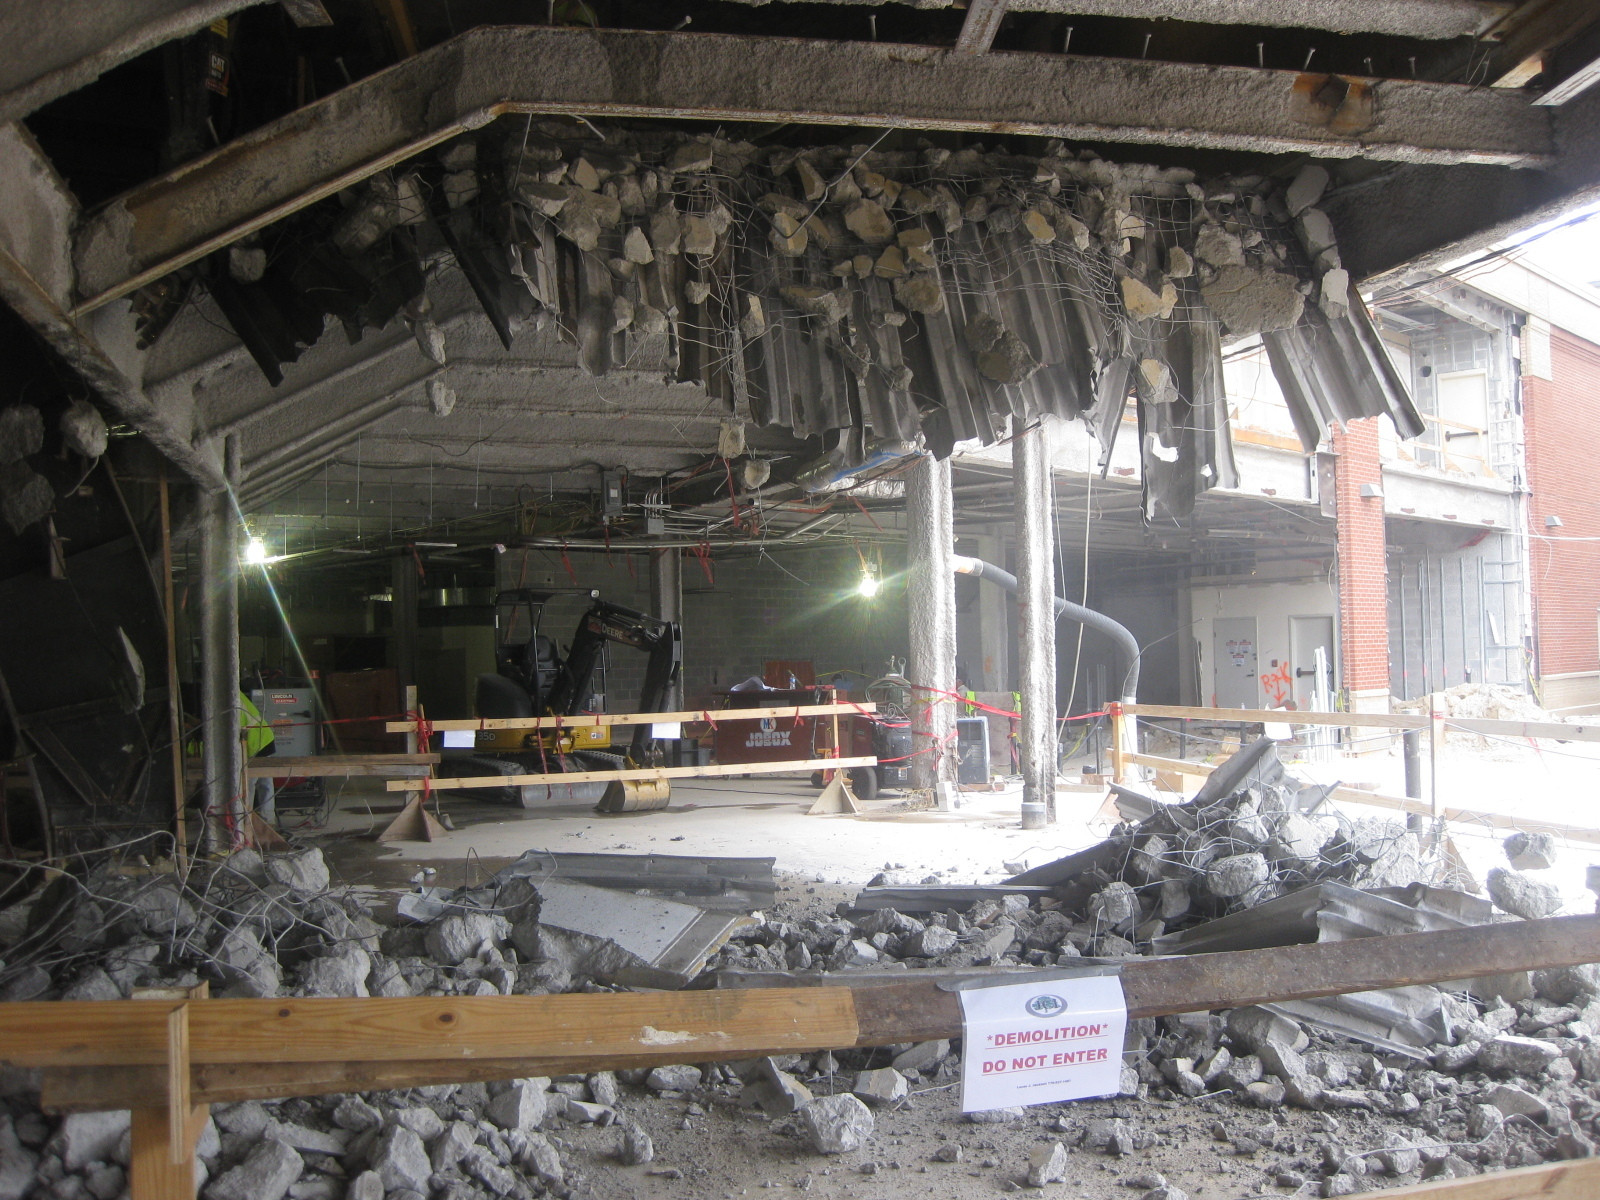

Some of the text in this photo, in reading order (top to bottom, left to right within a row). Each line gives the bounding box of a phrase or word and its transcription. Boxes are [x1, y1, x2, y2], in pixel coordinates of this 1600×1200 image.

[211, 53, 226, 74] CAT
[601, 623, 624, 640] DEERE
[745, 731, 792, 747] JOBOX
[982, 1048, 1108, 1073] DO NOT ENTER
